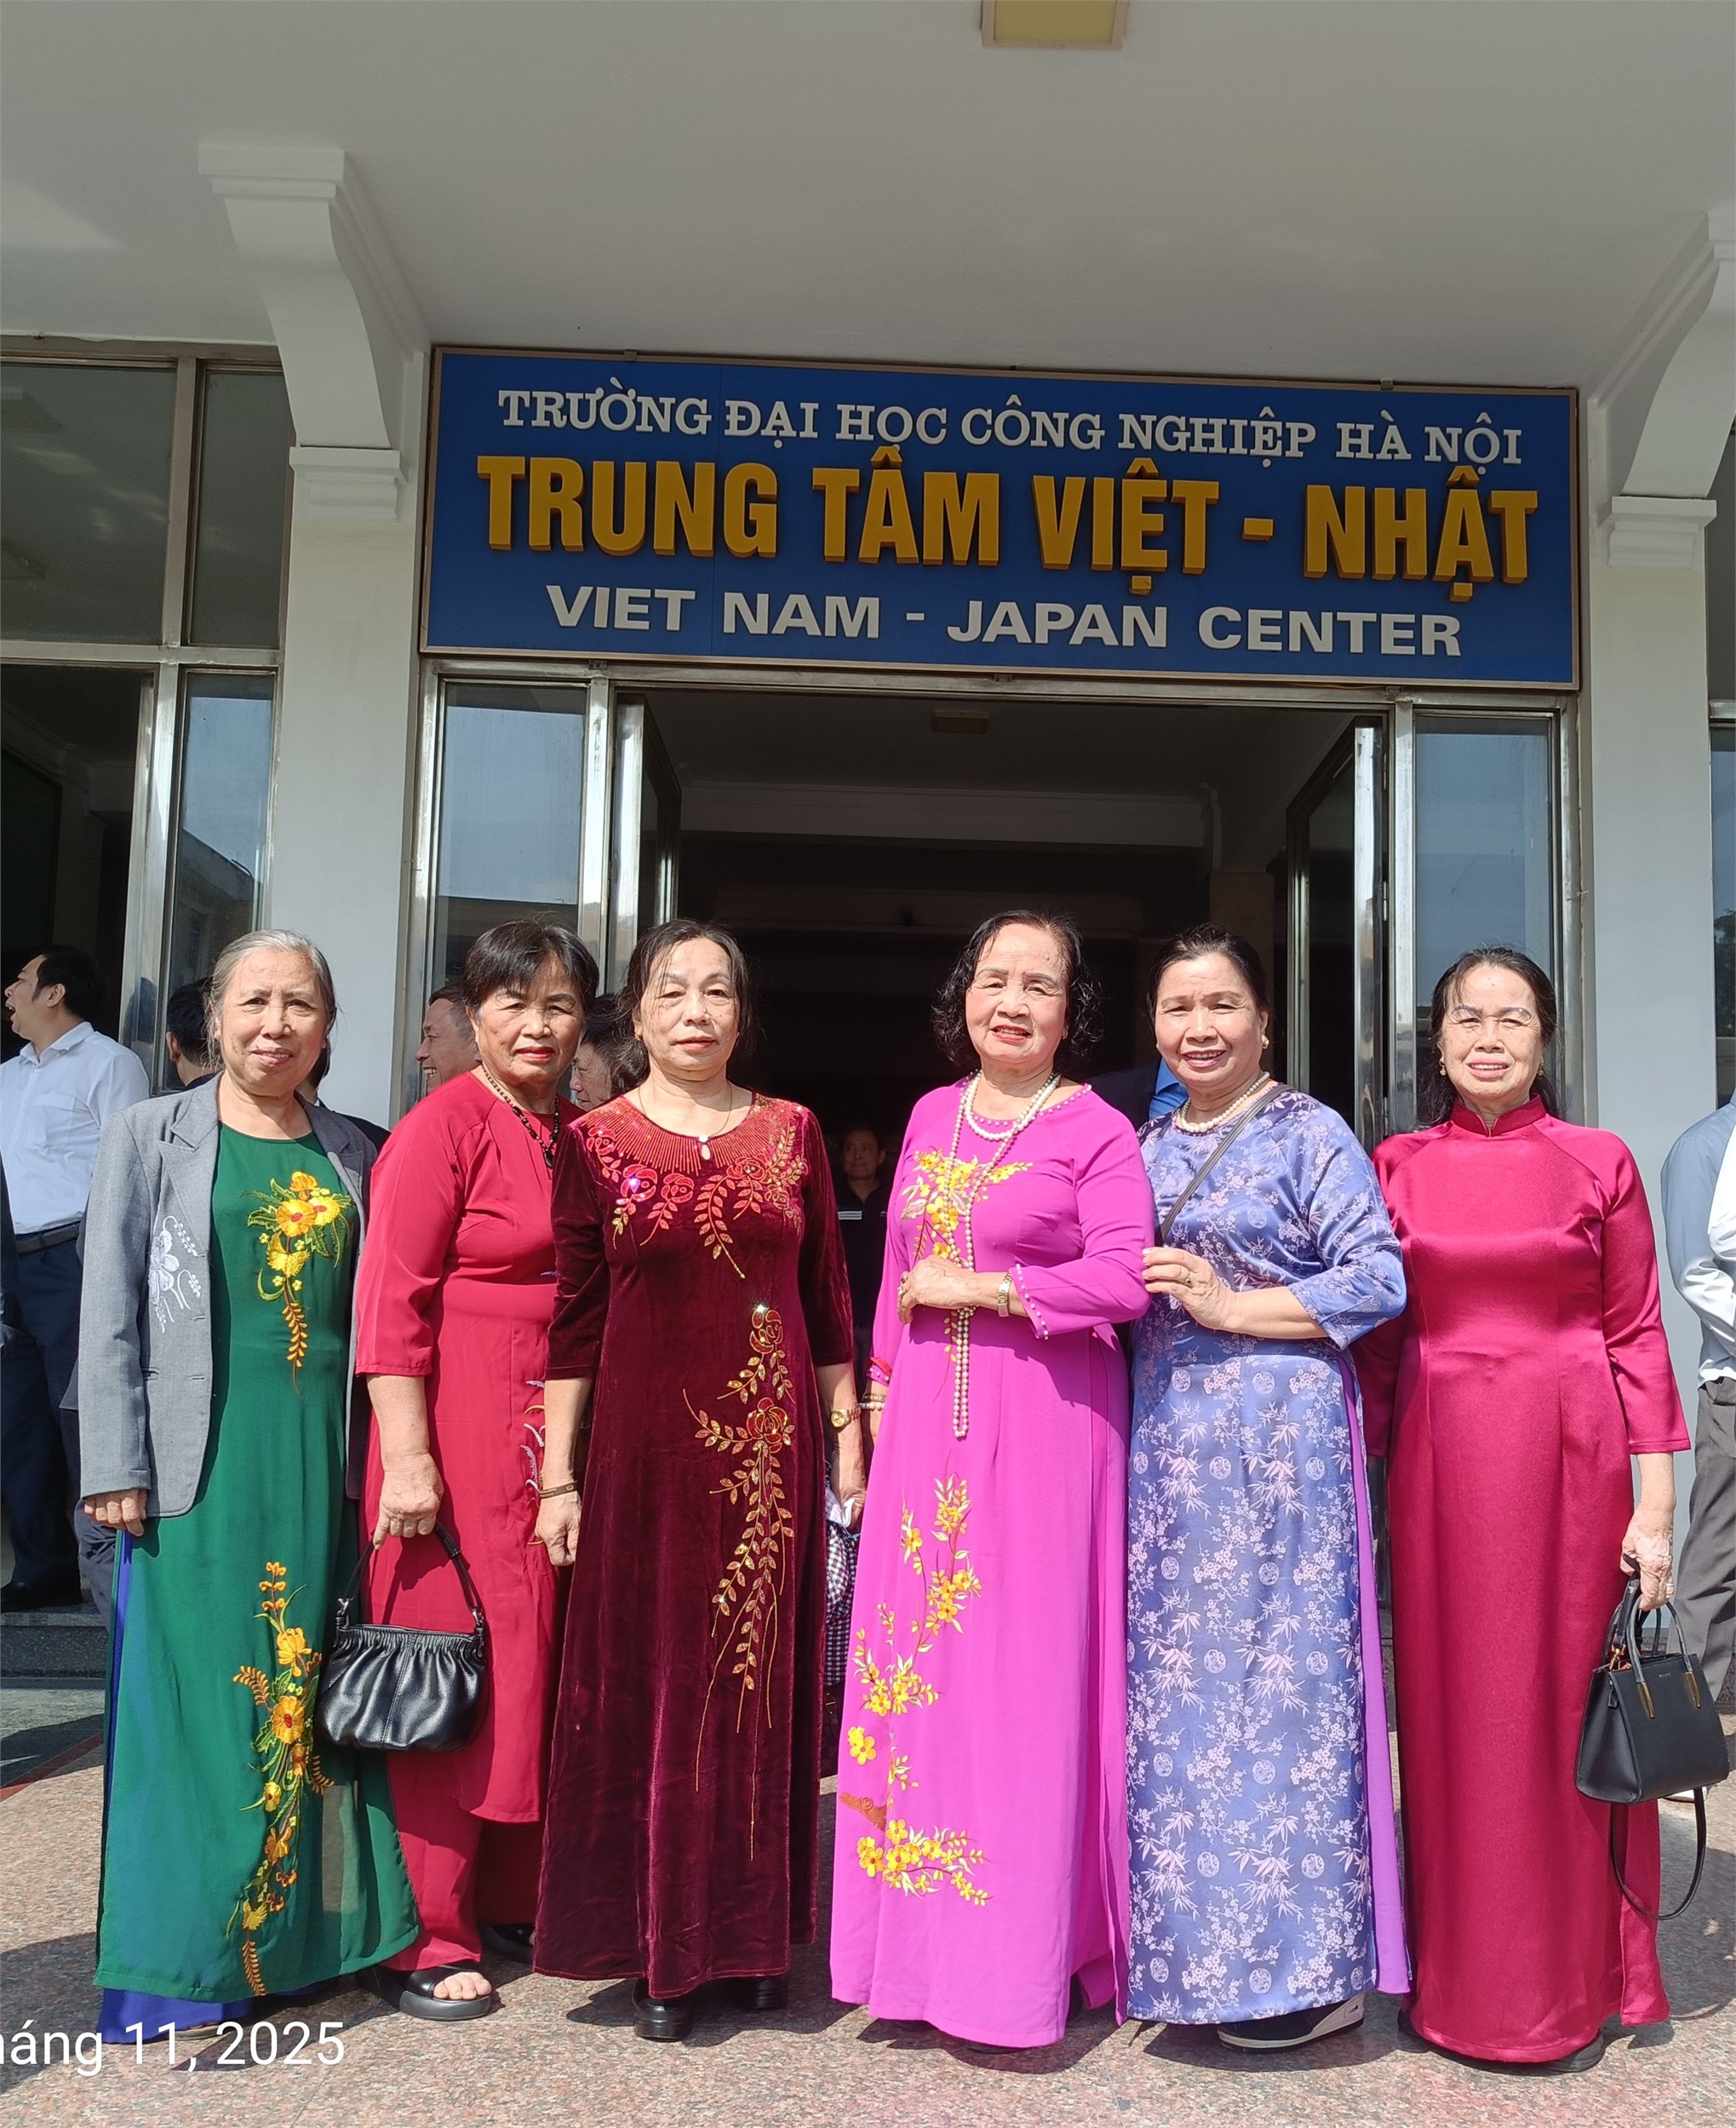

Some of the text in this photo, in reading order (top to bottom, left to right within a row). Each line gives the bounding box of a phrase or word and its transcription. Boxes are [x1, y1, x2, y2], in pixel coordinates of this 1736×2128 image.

[498, 377, 712, 436] TRƯỜNG
[724, 399, 819, 449] ĐẠI
[961, 395, 1106, 449] CÔNG
[1117, 407, 1316, 468] NGHIỆP
[1336, 410, 1412, 461] HÀ
[1424, 412, 1523, 475] NỘI
[478, 445, 1539, 603] TRUNG TÂM VIỆT - NHẬT
[546, 584, 1463, 657] VIET NAM - JAPAN CENTER
